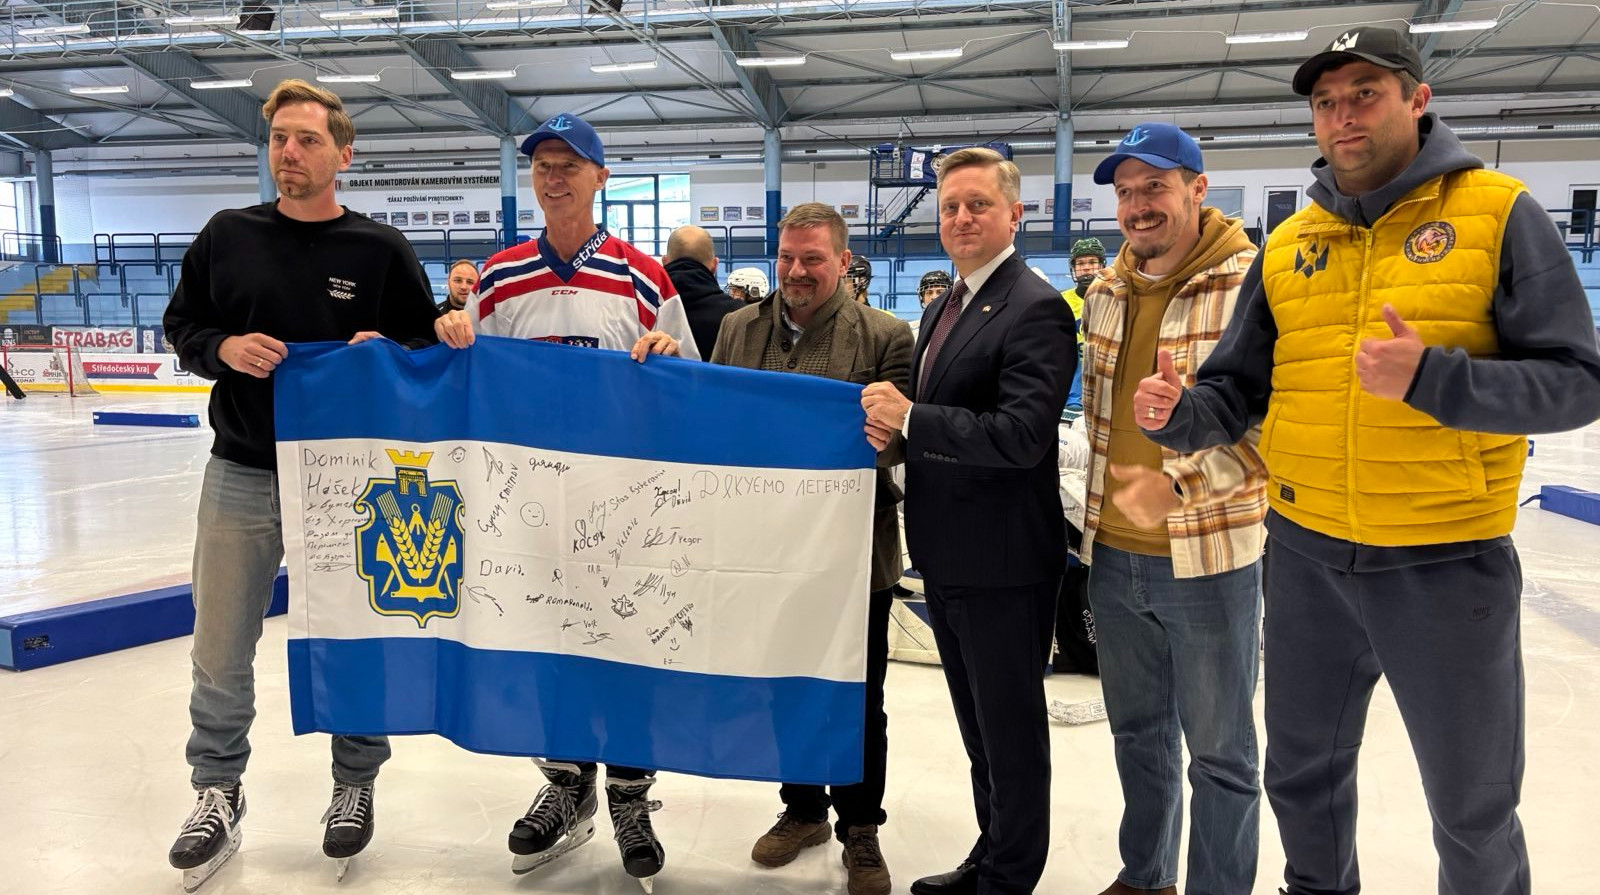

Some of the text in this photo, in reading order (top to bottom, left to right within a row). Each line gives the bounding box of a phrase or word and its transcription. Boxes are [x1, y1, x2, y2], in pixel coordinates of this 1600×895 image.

[349, 175, 500, 187] OBJEKT MONITOROVÁN KAMEROVÝM SYSTÉMEM
[54, 331, 133, 347] STRABAG
[92, 363, 150, 374] Středočeský kraj
[304, 448, 378, 470] Dominik
[308, 473, 361, 498] Hášek
